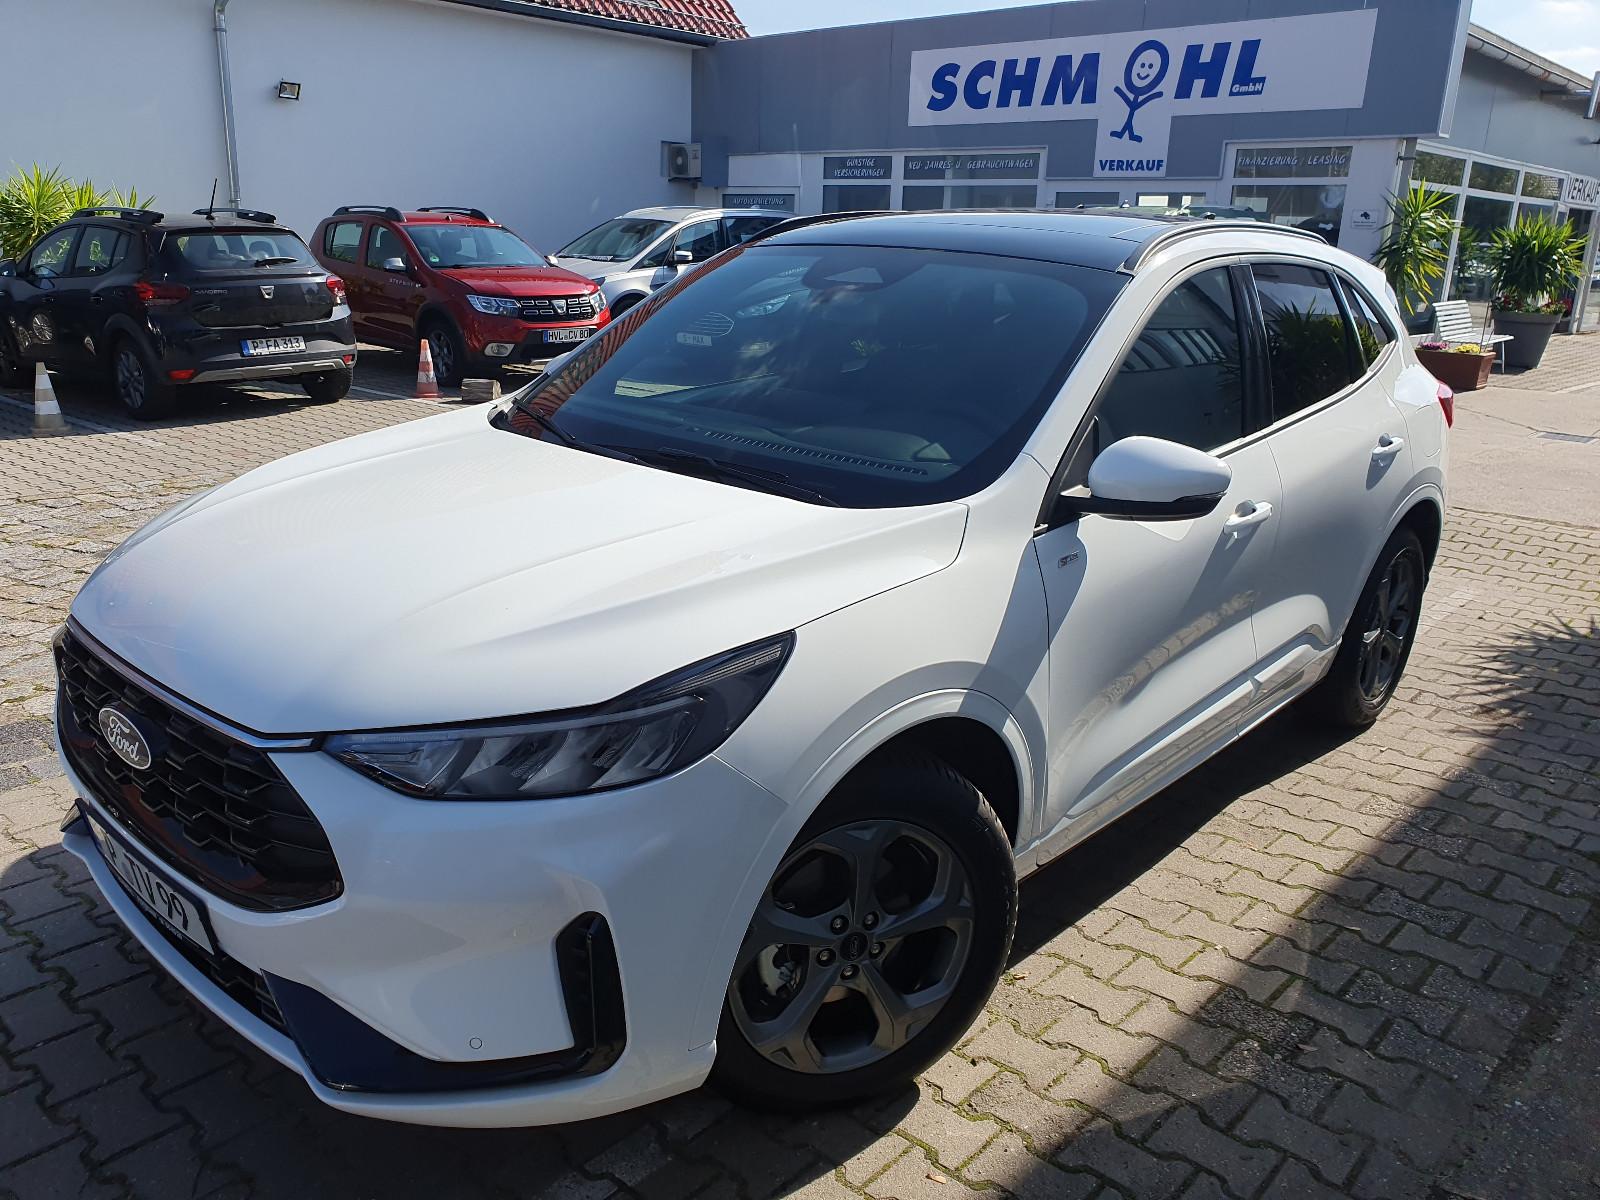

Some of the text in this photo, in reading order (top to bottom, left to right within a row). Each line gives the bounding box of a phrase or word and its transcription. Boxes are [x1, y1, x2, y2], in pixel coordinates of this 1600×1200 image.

[1231, 81, 1264, 94] GmbH
[967, 159, 1035, 169] GEBRAUCHTWAGEN
[1099, 158, 1164, 172] VERKAUF
[1237, 156, 1298, 166] FINANZIERUNG
[1307, 154, 1346, 165] LEASING
[548, 329, 589, 341] HVL CV 80
[251, 337, 301, 352] P FA 313
[107, 715, 140, 762] Ford
[155, 879, 190, 932] 99
